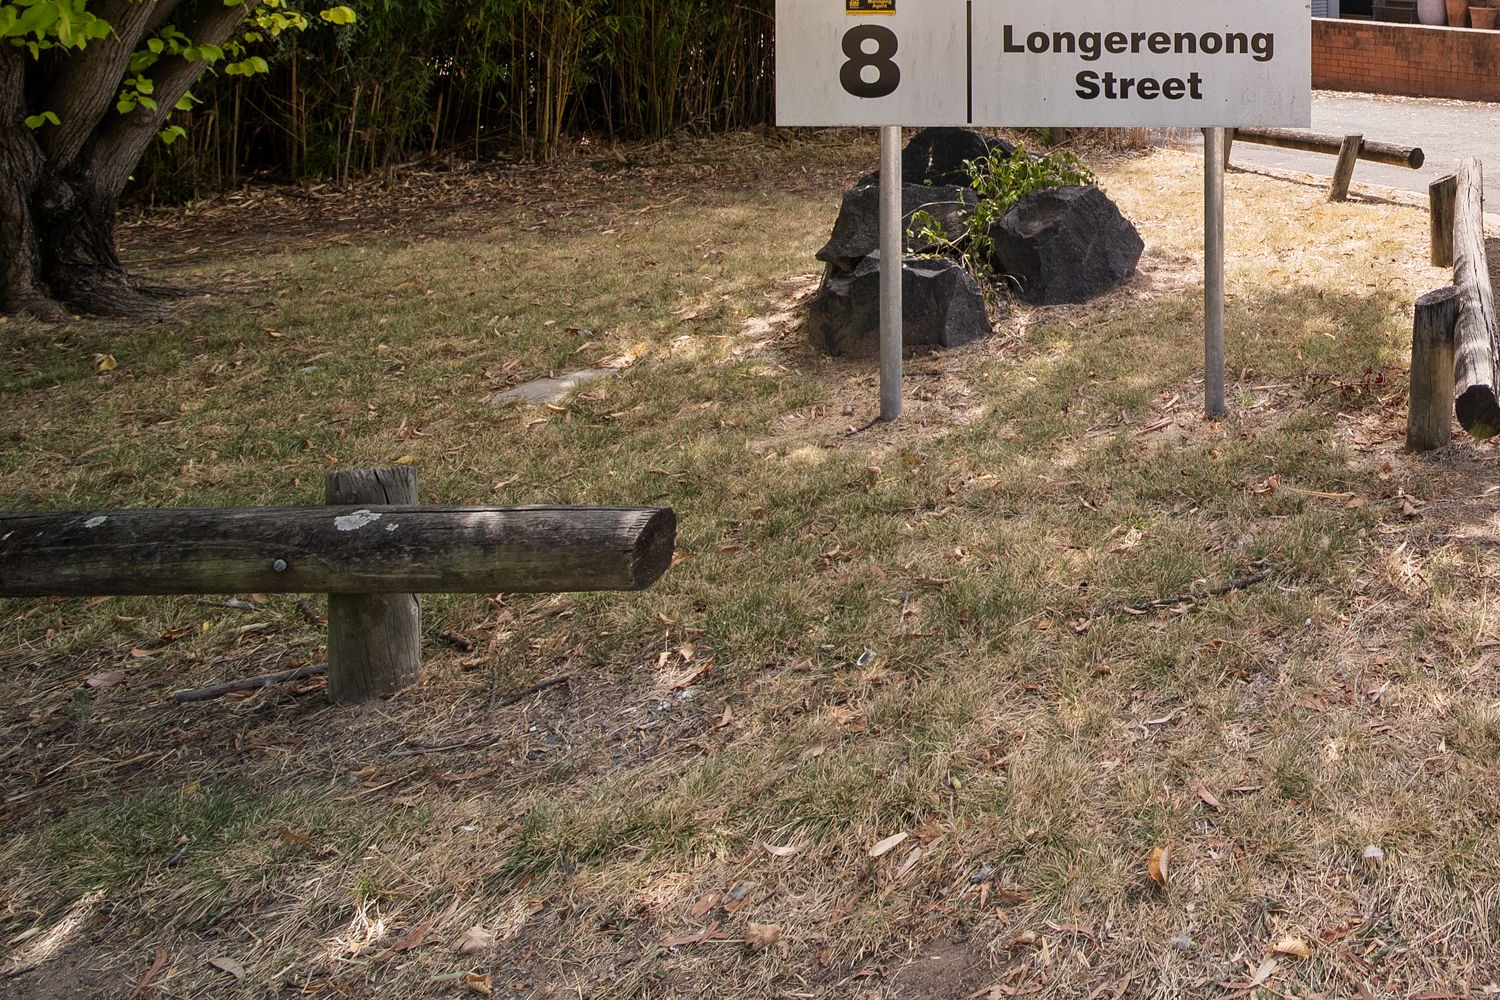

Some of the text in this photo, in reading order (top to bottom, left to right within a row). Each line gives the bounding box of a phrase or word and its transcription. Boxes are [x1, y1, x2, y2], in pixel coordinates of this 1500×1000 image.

[840, 24, 901, 98] 8
[1003, 25, 1275, 62] Longerenong
[1075, 70, 1203, 100] Street
